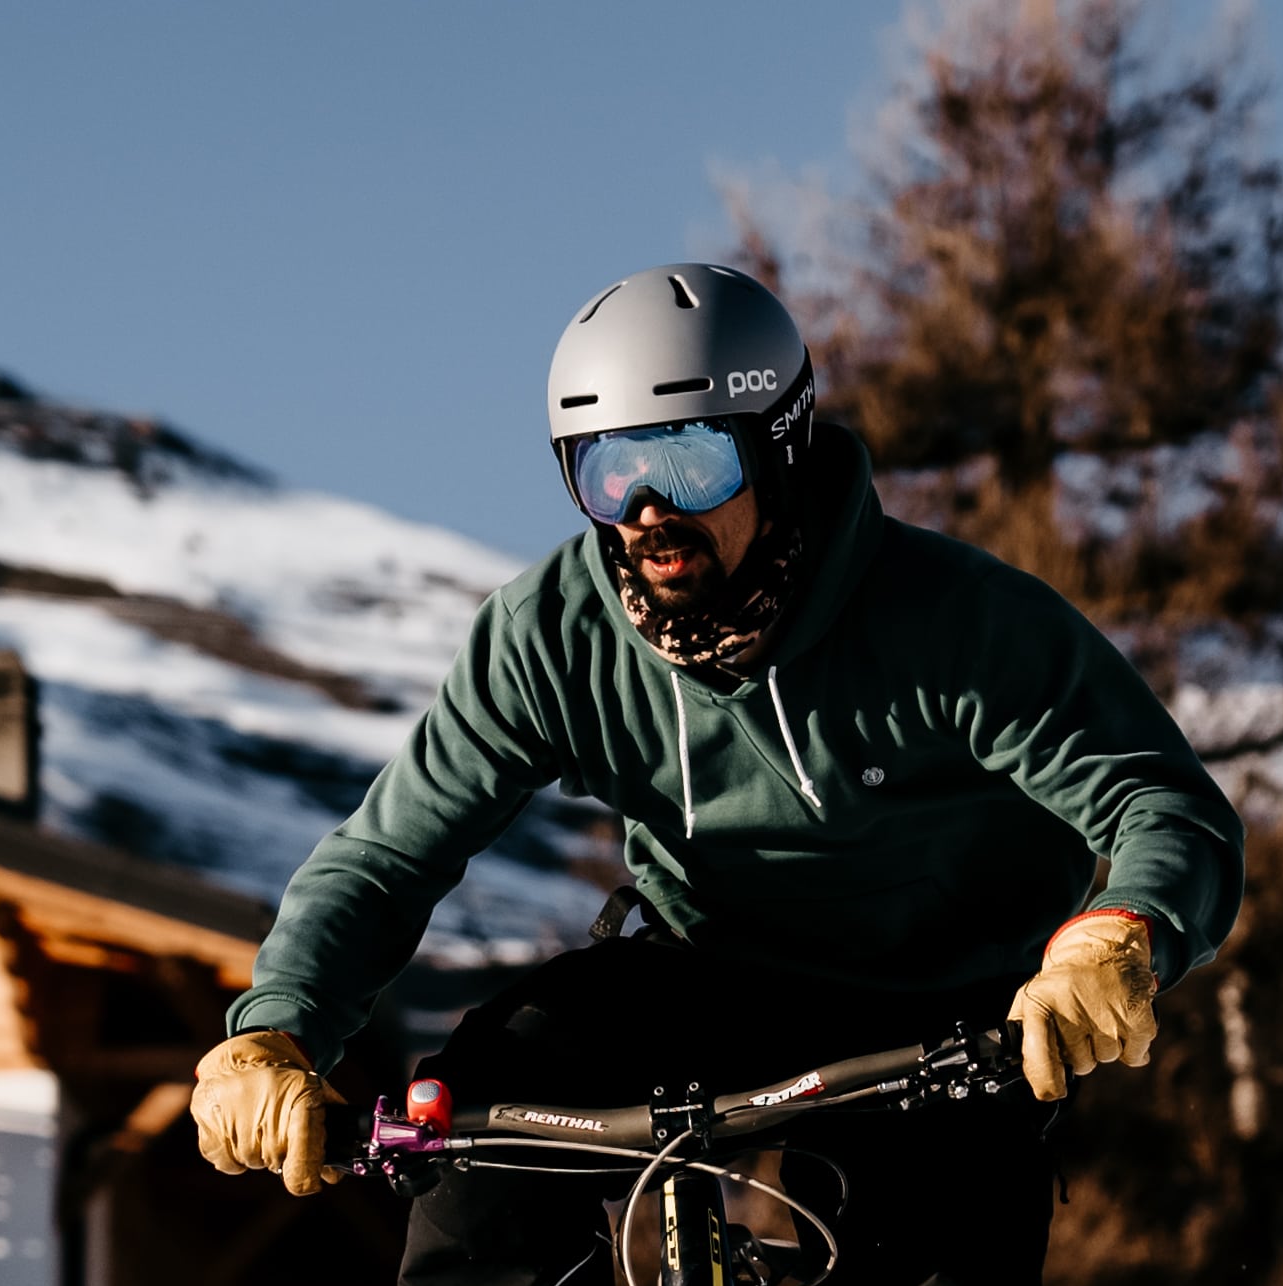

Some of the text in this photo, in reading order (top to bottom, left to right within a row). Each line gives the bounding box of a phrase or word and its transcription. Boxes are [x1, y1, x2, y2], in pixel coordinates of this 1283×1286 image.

[727, 369, 777, 398] poc
[771, 378, 814, 440] SMITH
[523, 1110, 605, 1132] RENTHAL
